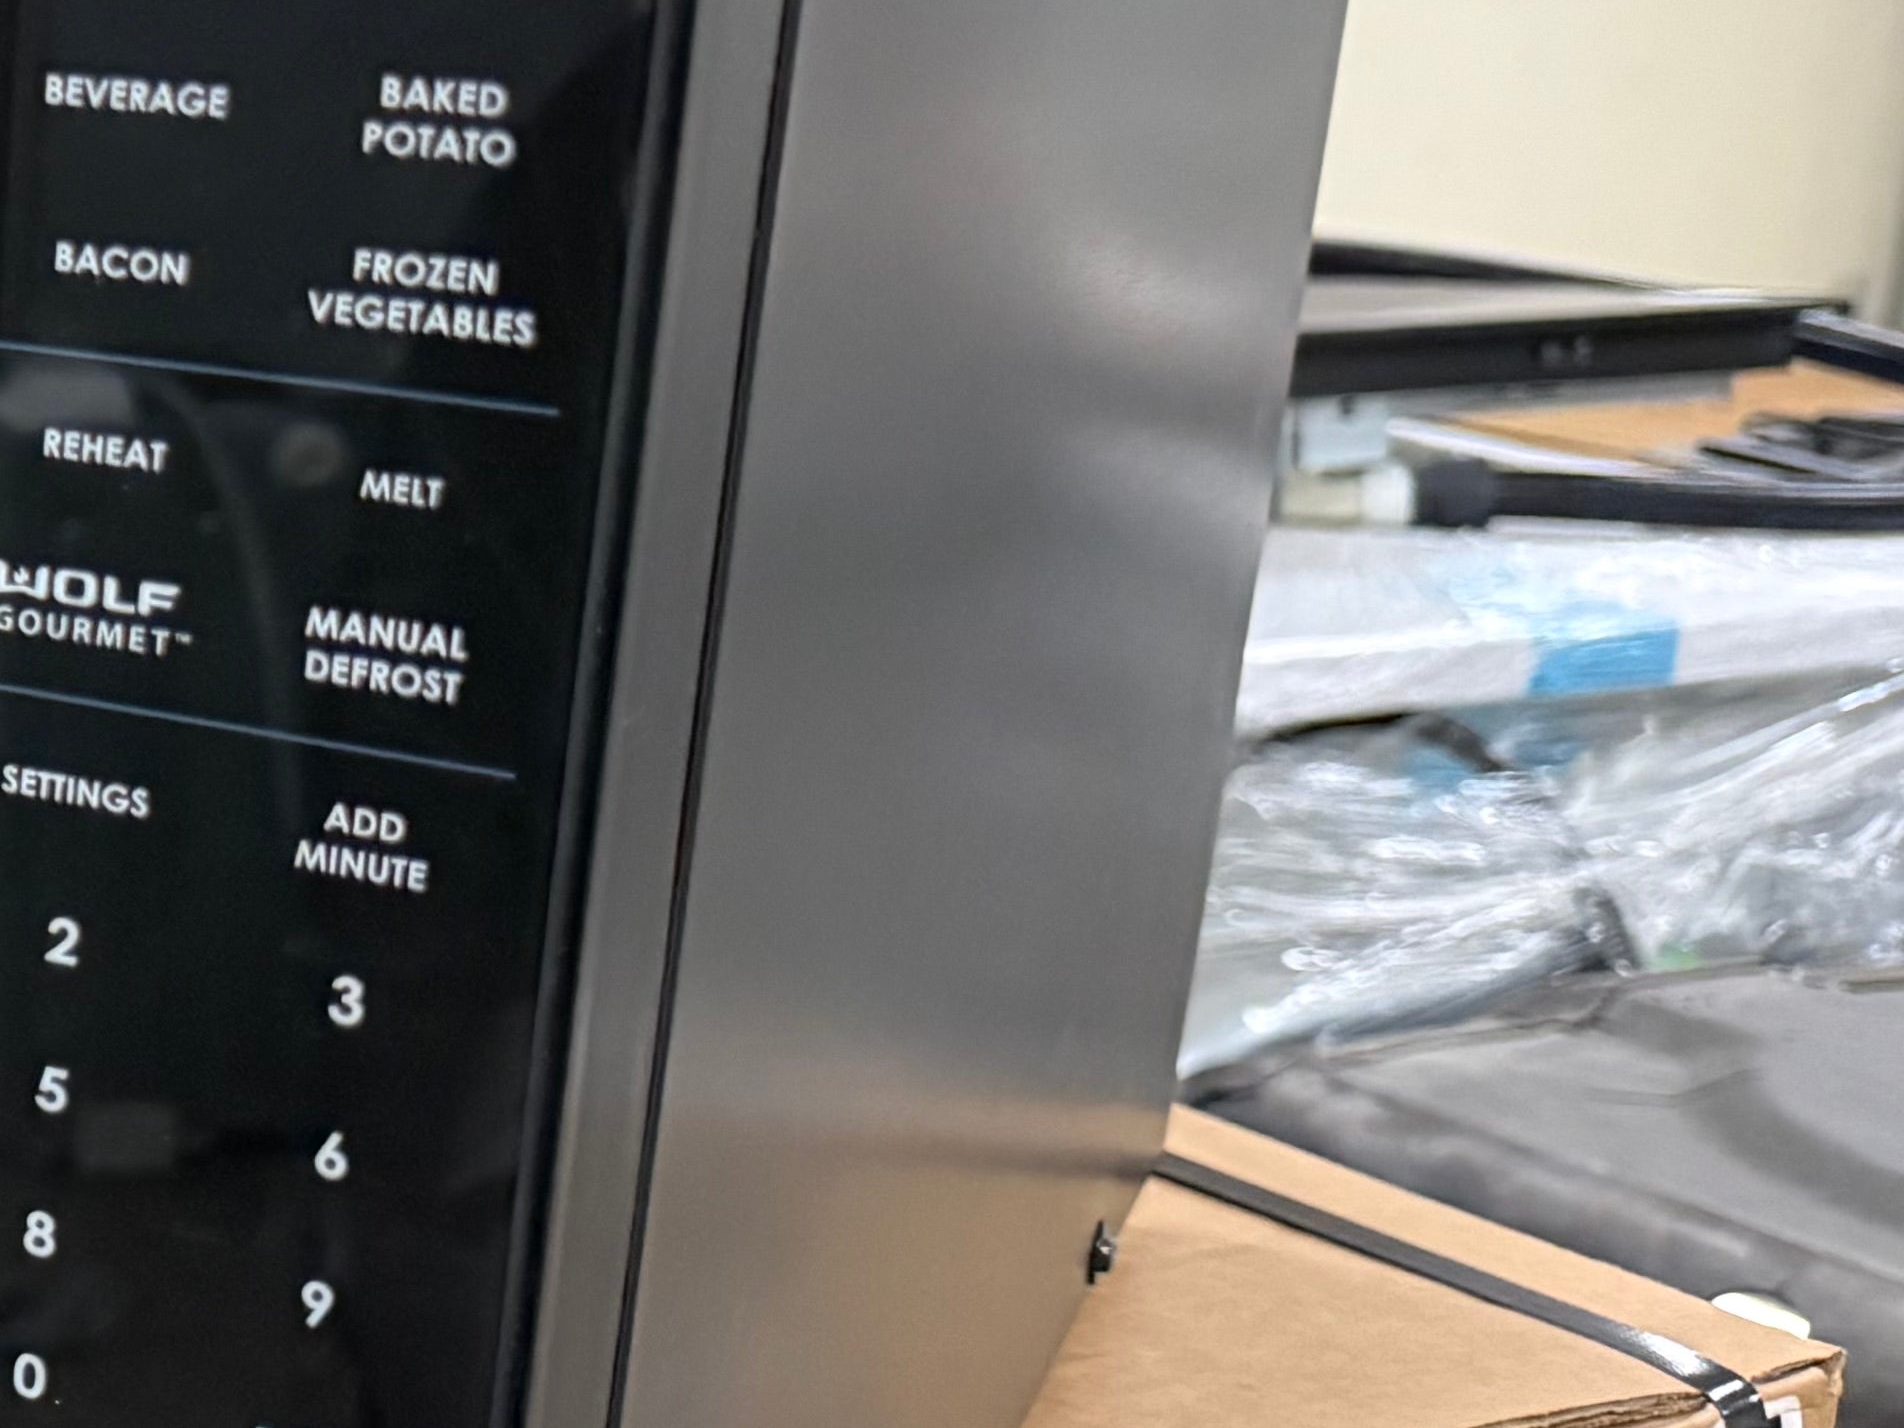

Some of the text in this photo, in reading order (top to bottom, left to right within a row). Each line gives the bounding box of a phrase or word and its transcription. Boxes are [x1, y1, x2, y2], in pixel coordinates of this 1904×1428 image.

[44, 72, 230, 119] BEVERAGE
[379, 74, 509, 117] BAKED
[361, 122, 517, 168] POTATO
[53, 241, 189, 287] BACON
[352, 248, 499, 296] FROZEN
[307, 289, 537, 347] VEGETABLES
[42, 428, 168, 475] REHEAT
[359, 467, 445, 510] MELT
[304, 607, 468, 662] MANUAL
[303, 649, 465, 707] DEFROST
[0, 763, 151, 820] SETTINGS
[322, 803, 407, 844] ADD
[293, 837, 429, 894] MINUTE
[43, 918, 82, 967] 2
[326, 976, 366, 1028] 3
[34, 1065, 70, 1115] 5
[313, 1132, 349, 1181] 6
[22, 1210, 57, 1258] 8
[299, 1280, 335, 1329] 9
[12, 1352, 47, 1400] 0
